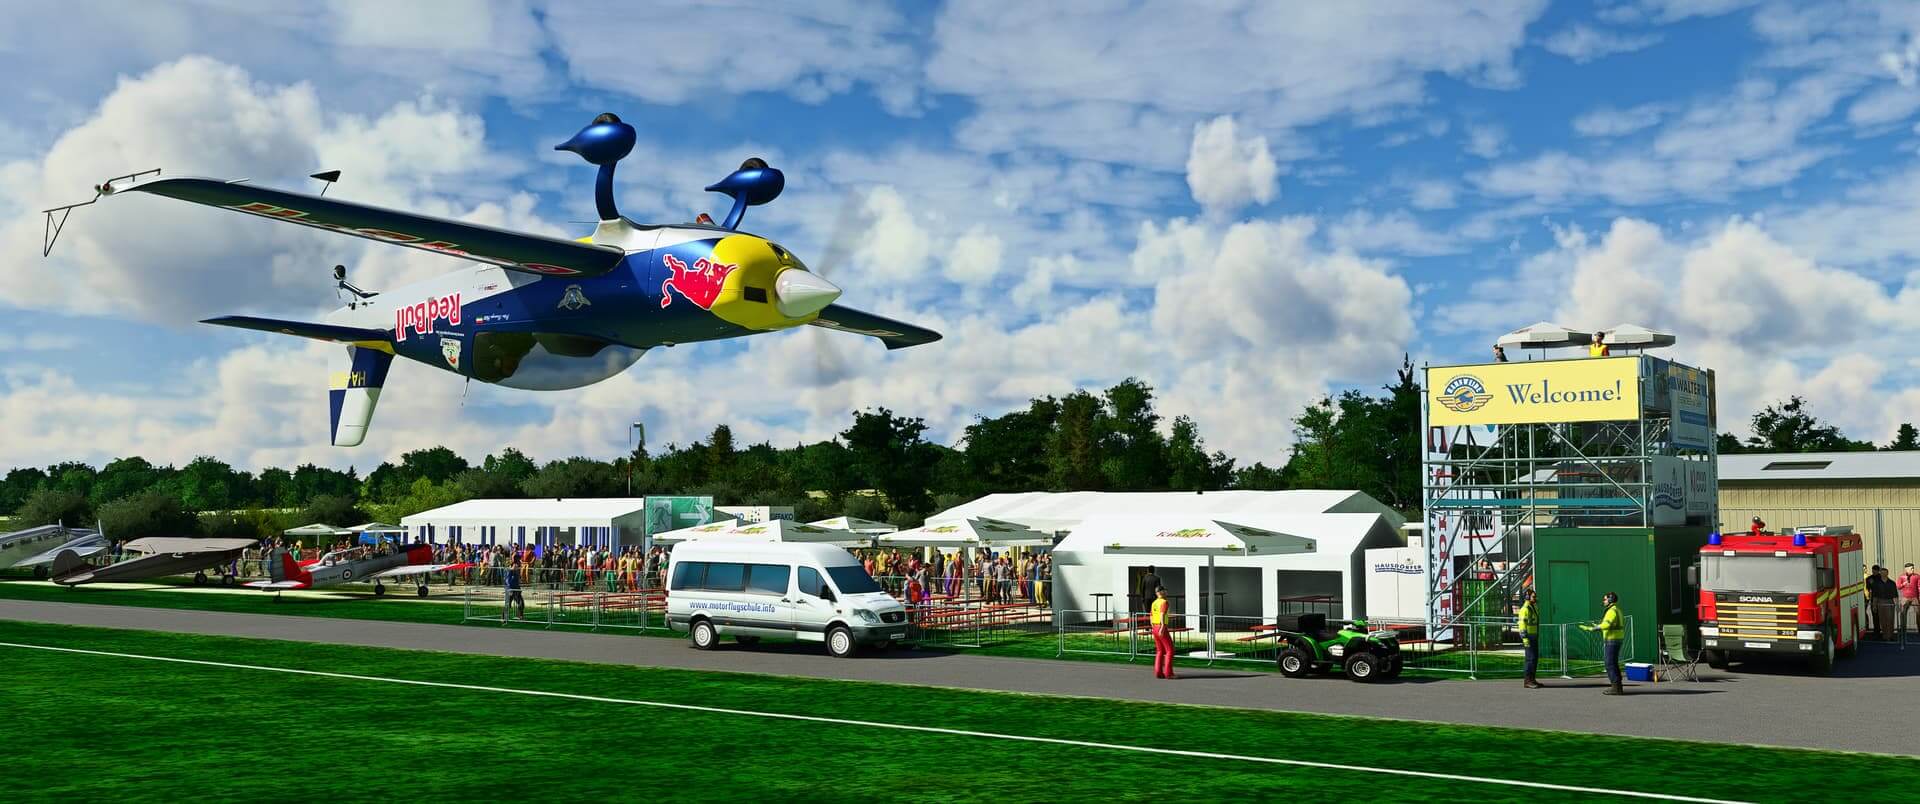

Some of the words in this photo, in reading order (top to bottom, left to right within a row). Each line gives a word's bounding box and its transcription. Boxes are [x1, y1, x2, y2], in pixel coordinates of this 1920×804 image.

[394, 301, 427, 343] Bull
[427, 292, 462, 335] Red
[1506, 379, 1622, 406] Welcome!
[689, 601, 776, 613] www.motorflugschule.info
[1739, 595, 1773, 603] SCANIA
